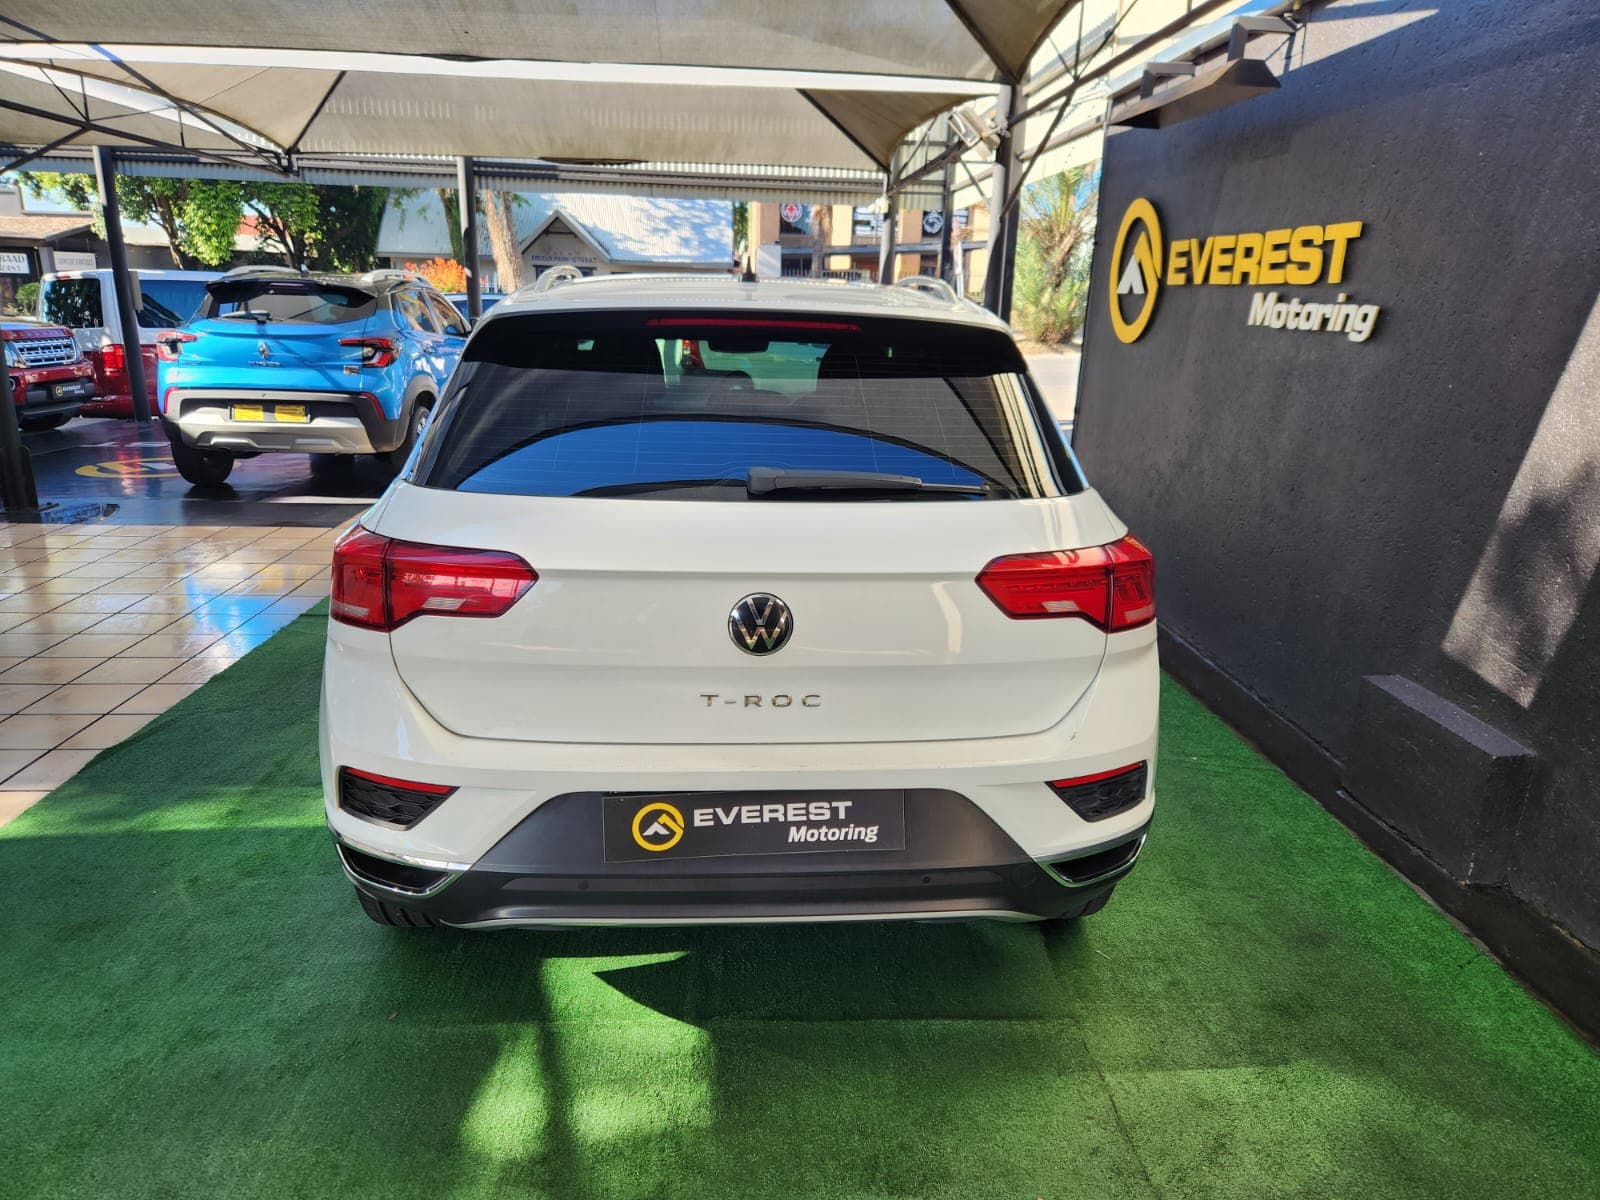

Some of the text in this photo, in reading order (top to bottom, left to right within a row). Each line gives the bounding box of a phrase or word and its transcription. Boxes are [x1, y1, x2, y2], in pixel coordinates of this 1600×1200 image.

[1167, 220, 1363, 286] EVEREST
[1248, 291, 1380, 343] Motoring
[700, 694, 822, 708] T-ROC
[693, 801, 853, 828] EVEREST
[788, 823, 879, 844] Motoring
